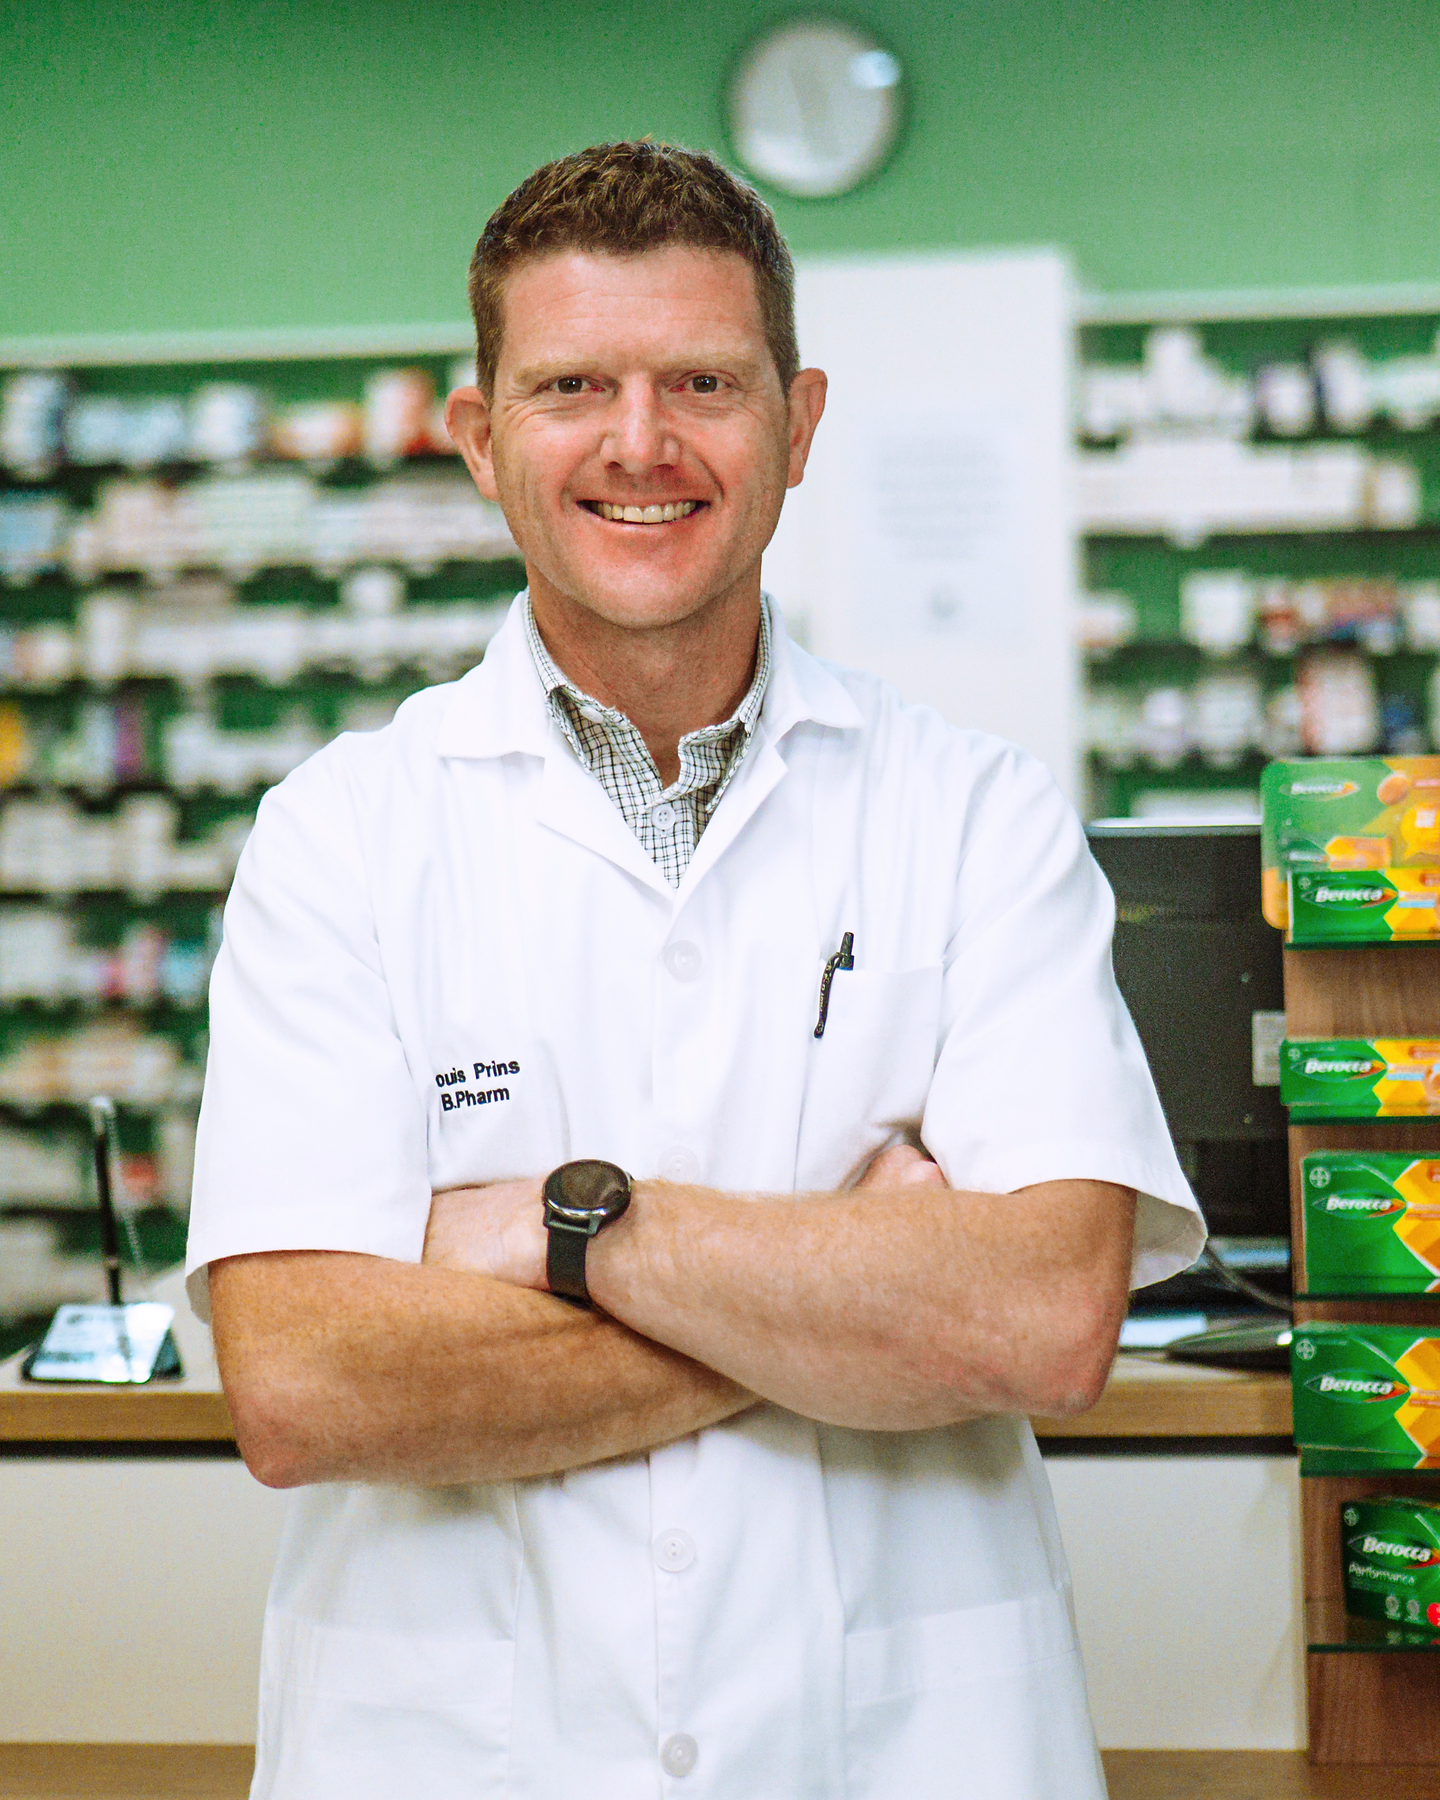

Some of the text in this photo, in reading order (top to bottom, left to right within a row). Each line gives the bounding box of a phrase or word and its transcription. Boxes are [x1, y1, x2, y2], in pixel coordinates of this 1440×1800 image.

[1315, 886, 1384, 902] Berocca
[435, 1060, 520, 1088] ouis Prins
[1304, 1057, 1372, 1074] Berocca
[441, 1087, 510, 1112] B.Pharm
[1325, 1193, 1392, 1211] Berocca
[1319, 1375, 1394, 1396] Berocca
[1363, 1536, 1432, 1562] Berocca
